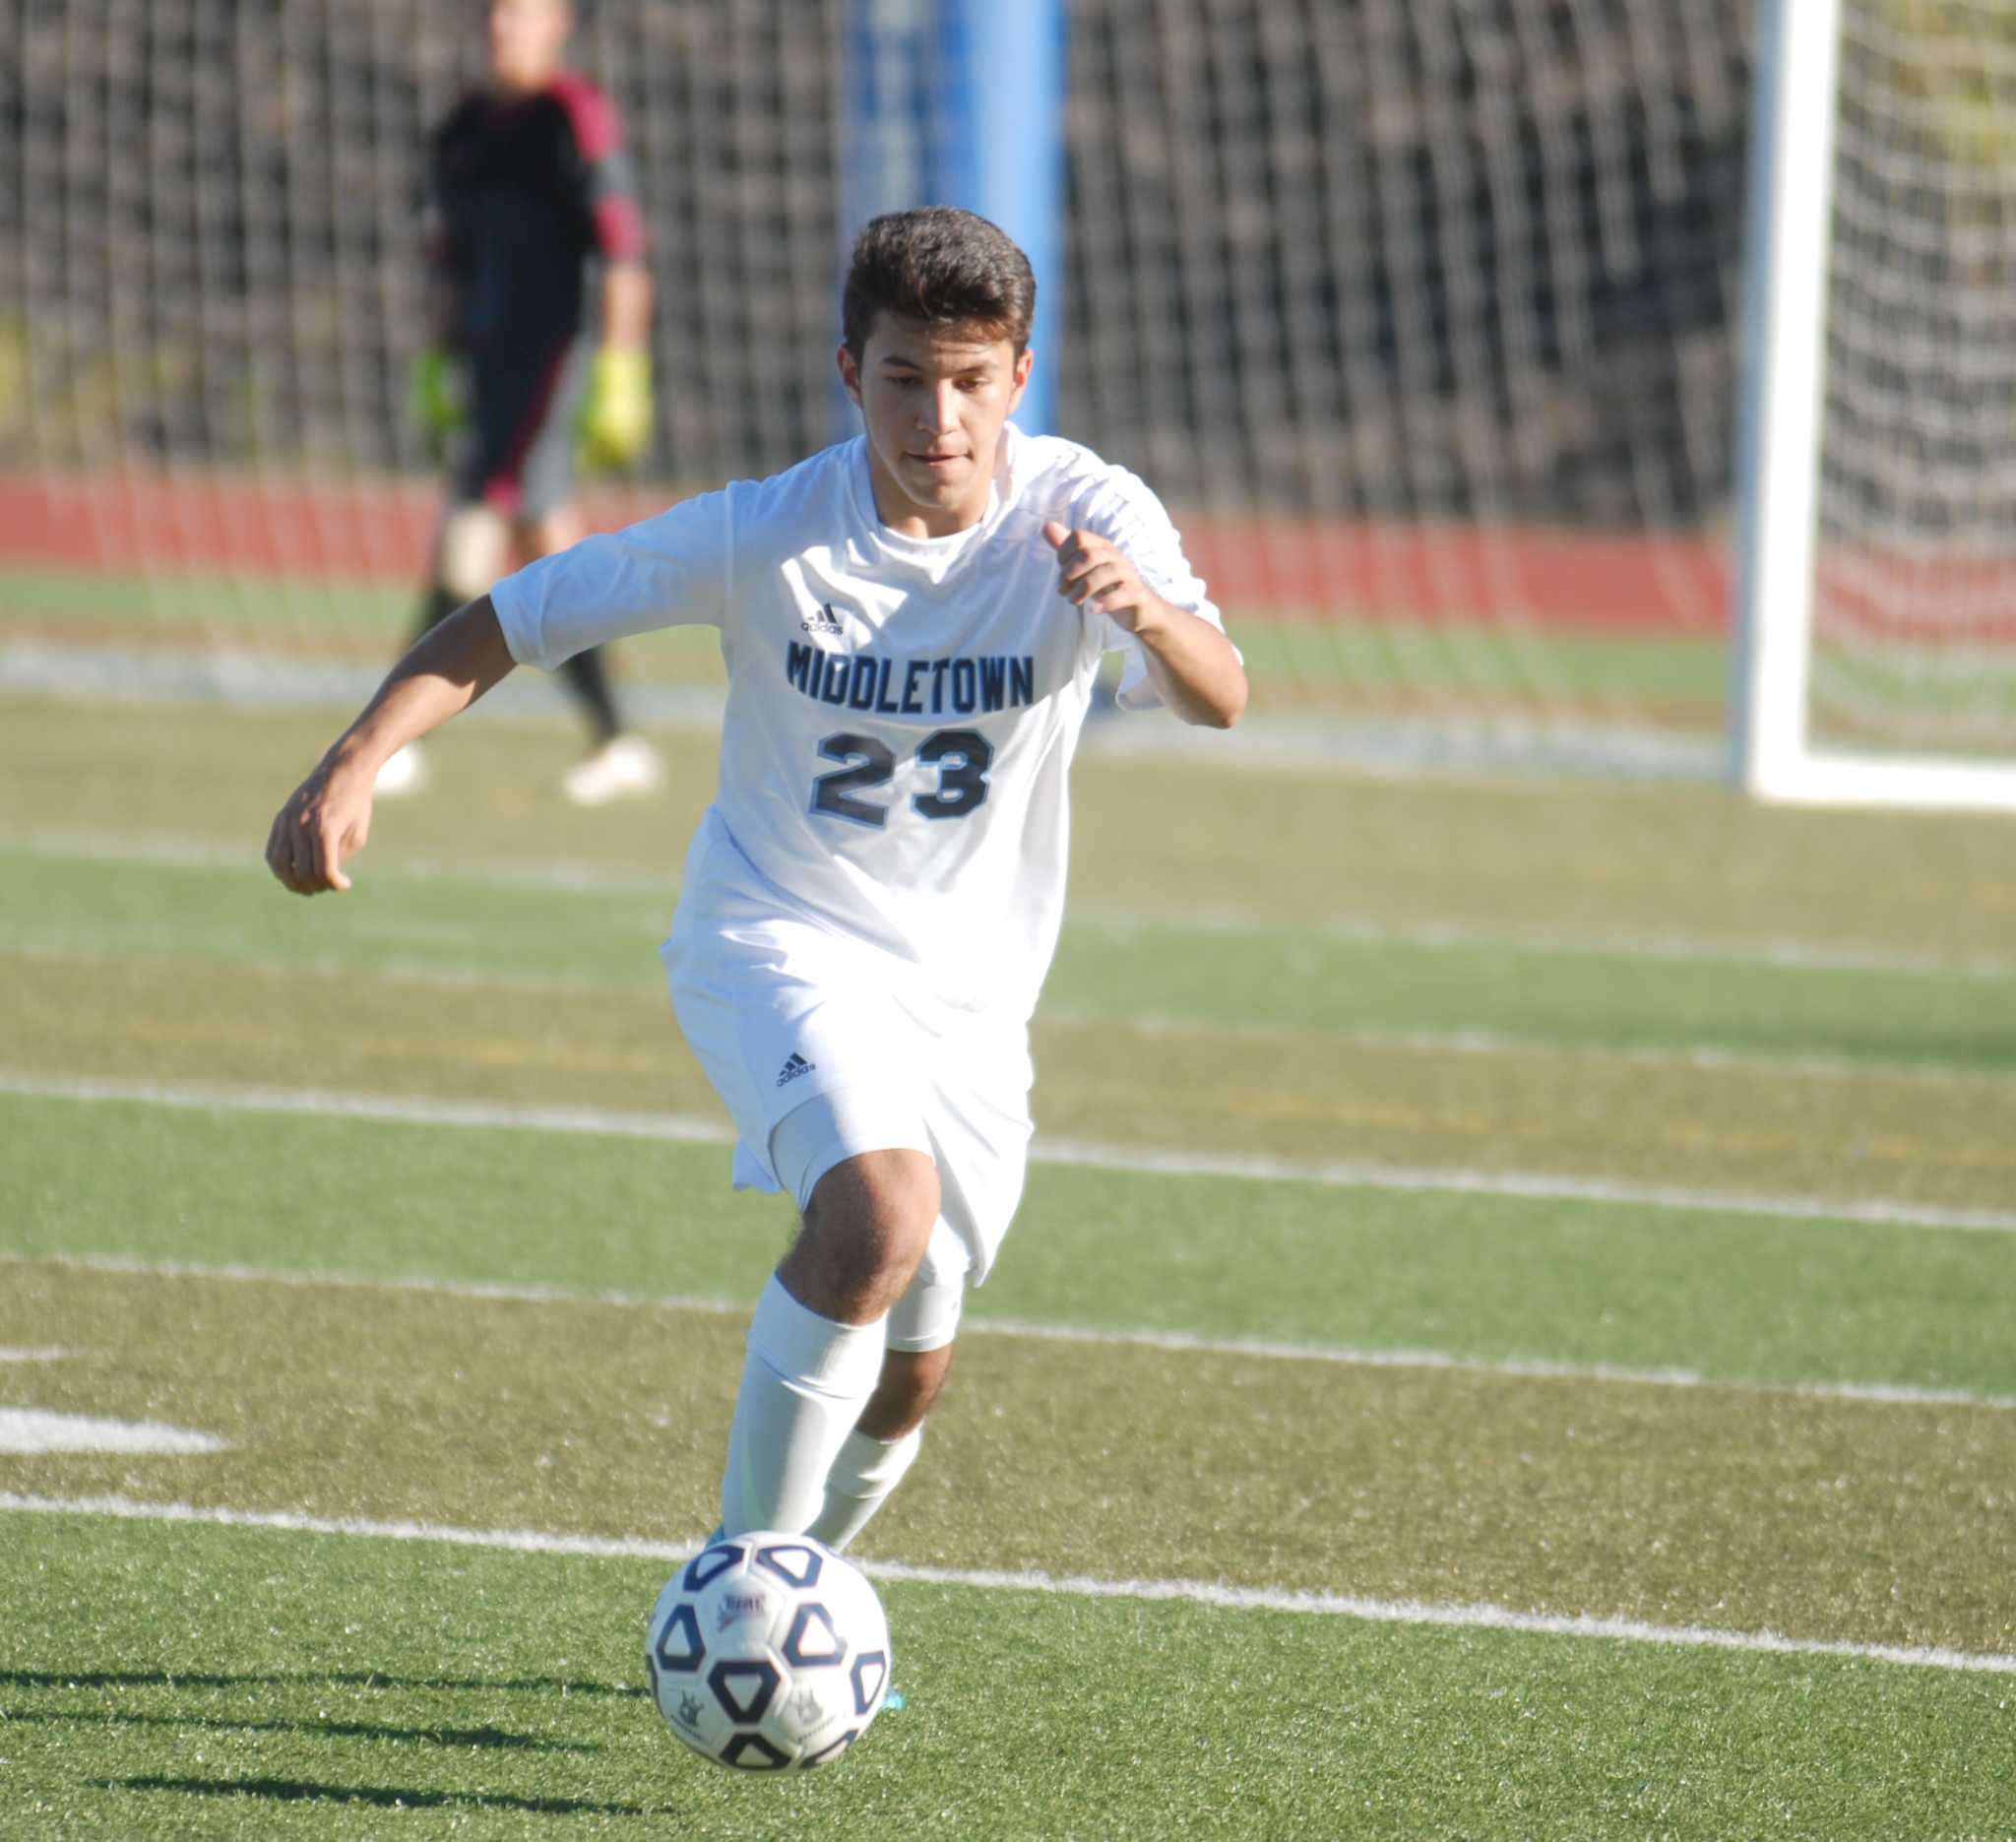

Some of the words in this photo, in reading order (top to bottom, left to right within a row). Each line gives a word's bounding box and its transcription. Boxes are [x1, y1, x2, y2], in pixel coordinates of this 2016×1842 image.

[800, 621, 844, 636] adidas
[787, 640, 1034, 714] MIDDLETOWN
[808, 729, 994, 830] 23
[776, 1062, 816, 1088] adidas
